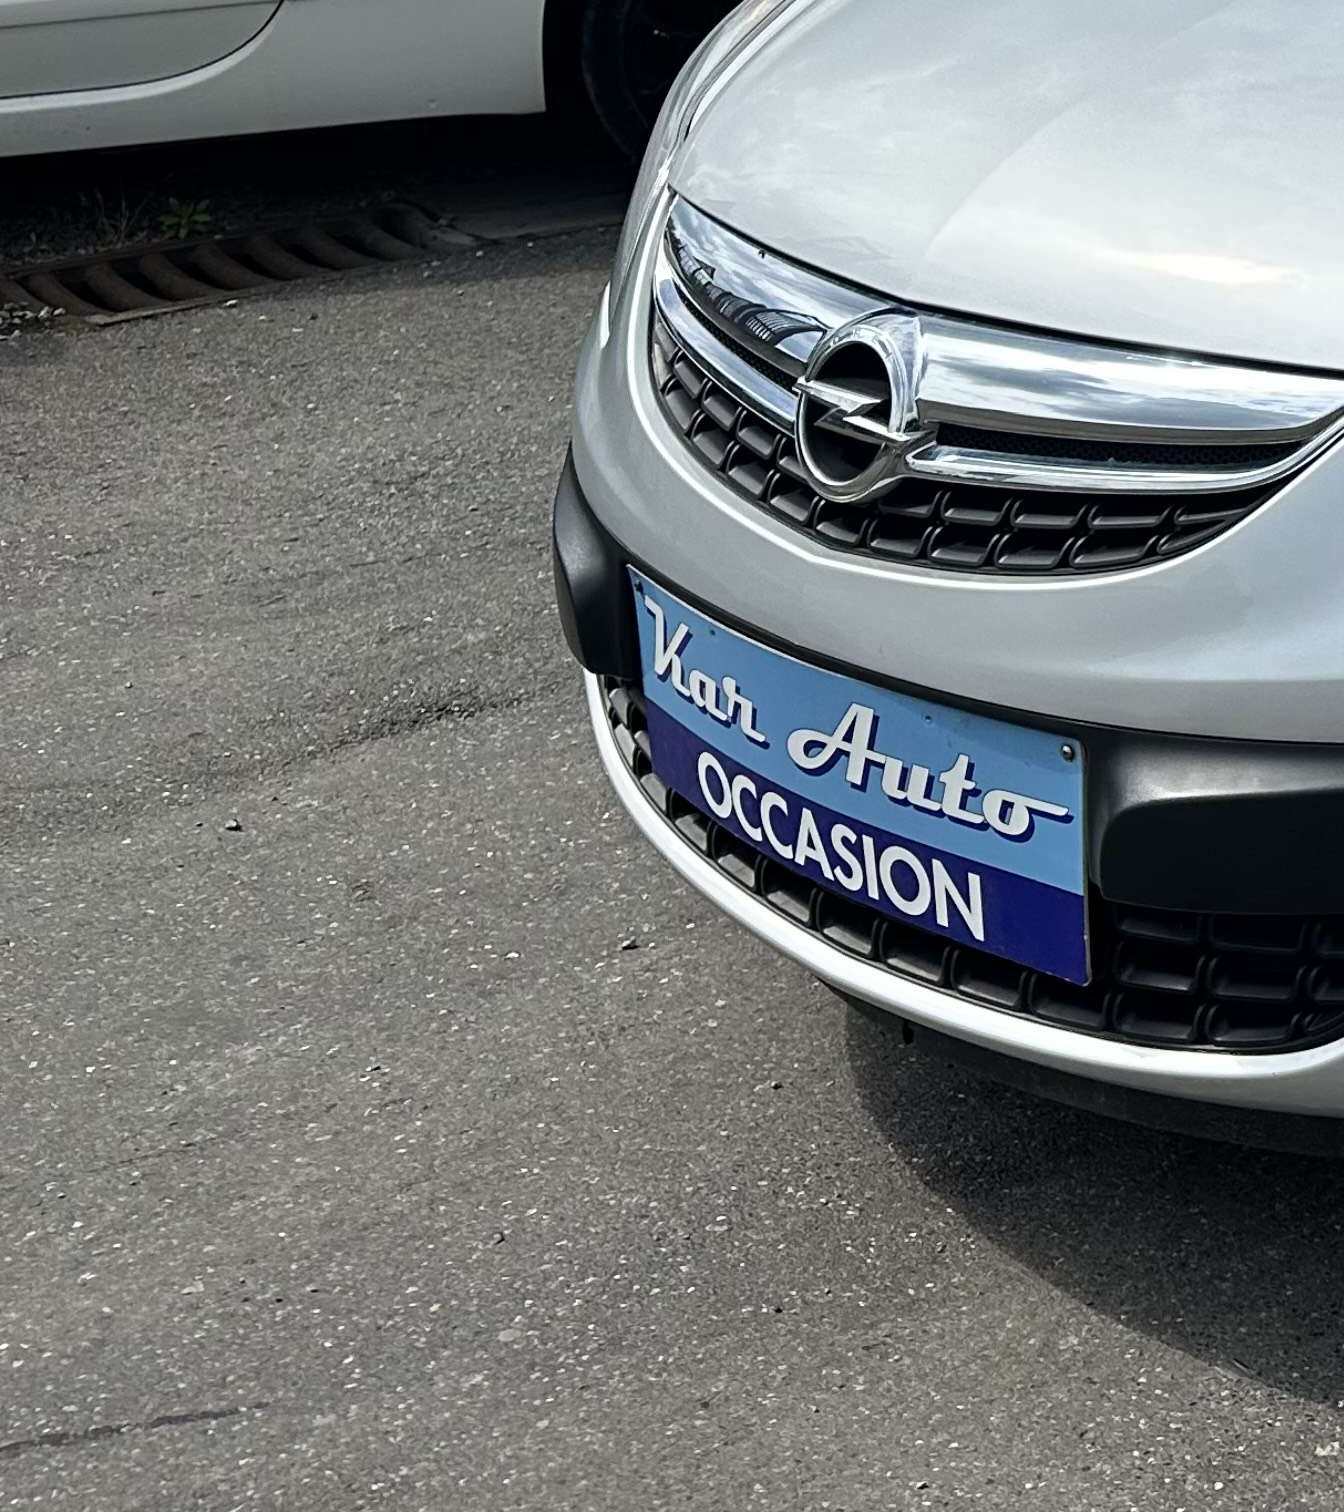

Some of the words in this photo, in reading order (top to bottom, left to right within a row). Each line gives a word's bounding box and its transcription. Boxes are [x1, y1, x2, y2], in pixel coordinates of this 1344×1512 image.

[644, 595, 767, 746] Kar
[787, 703, 1072, 838] Auto
[697, 750, 986, 942] OCCASION
